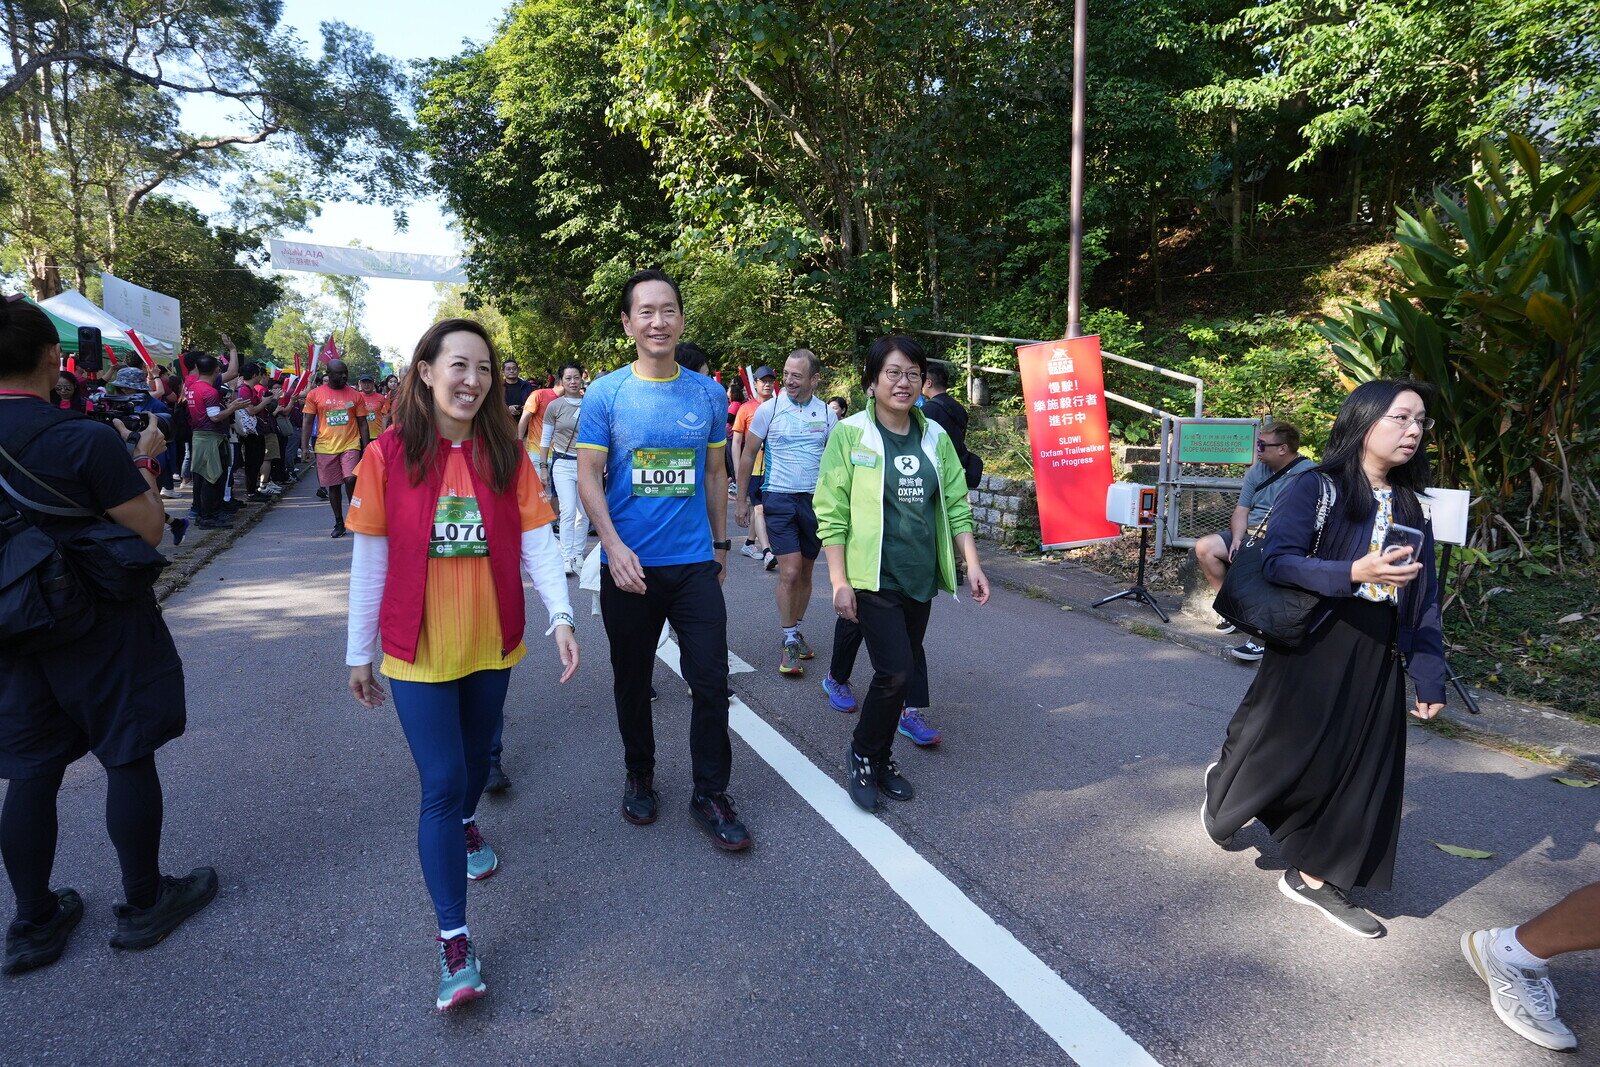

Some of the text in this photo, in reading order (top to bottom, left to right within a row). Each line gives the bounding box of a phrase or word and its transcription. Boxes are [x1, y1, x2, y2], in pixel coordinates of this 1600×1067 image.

[1033, 394, 1098, 413] 樂施毅行者
[1048, 412, 1087, 427] 進行中
[1058, 435, 1082, 445] SLOW!
[1040, 444, 1106, 459] Oxfam Trailwalker
[1061, 457, 1094, 468] Progress
[641, 470, 686, 484] L001
[898, 477, 923, 487] 樂施會
[898, 487, 924, 496] OXFAM
[431, 523, 486, 541] L070
